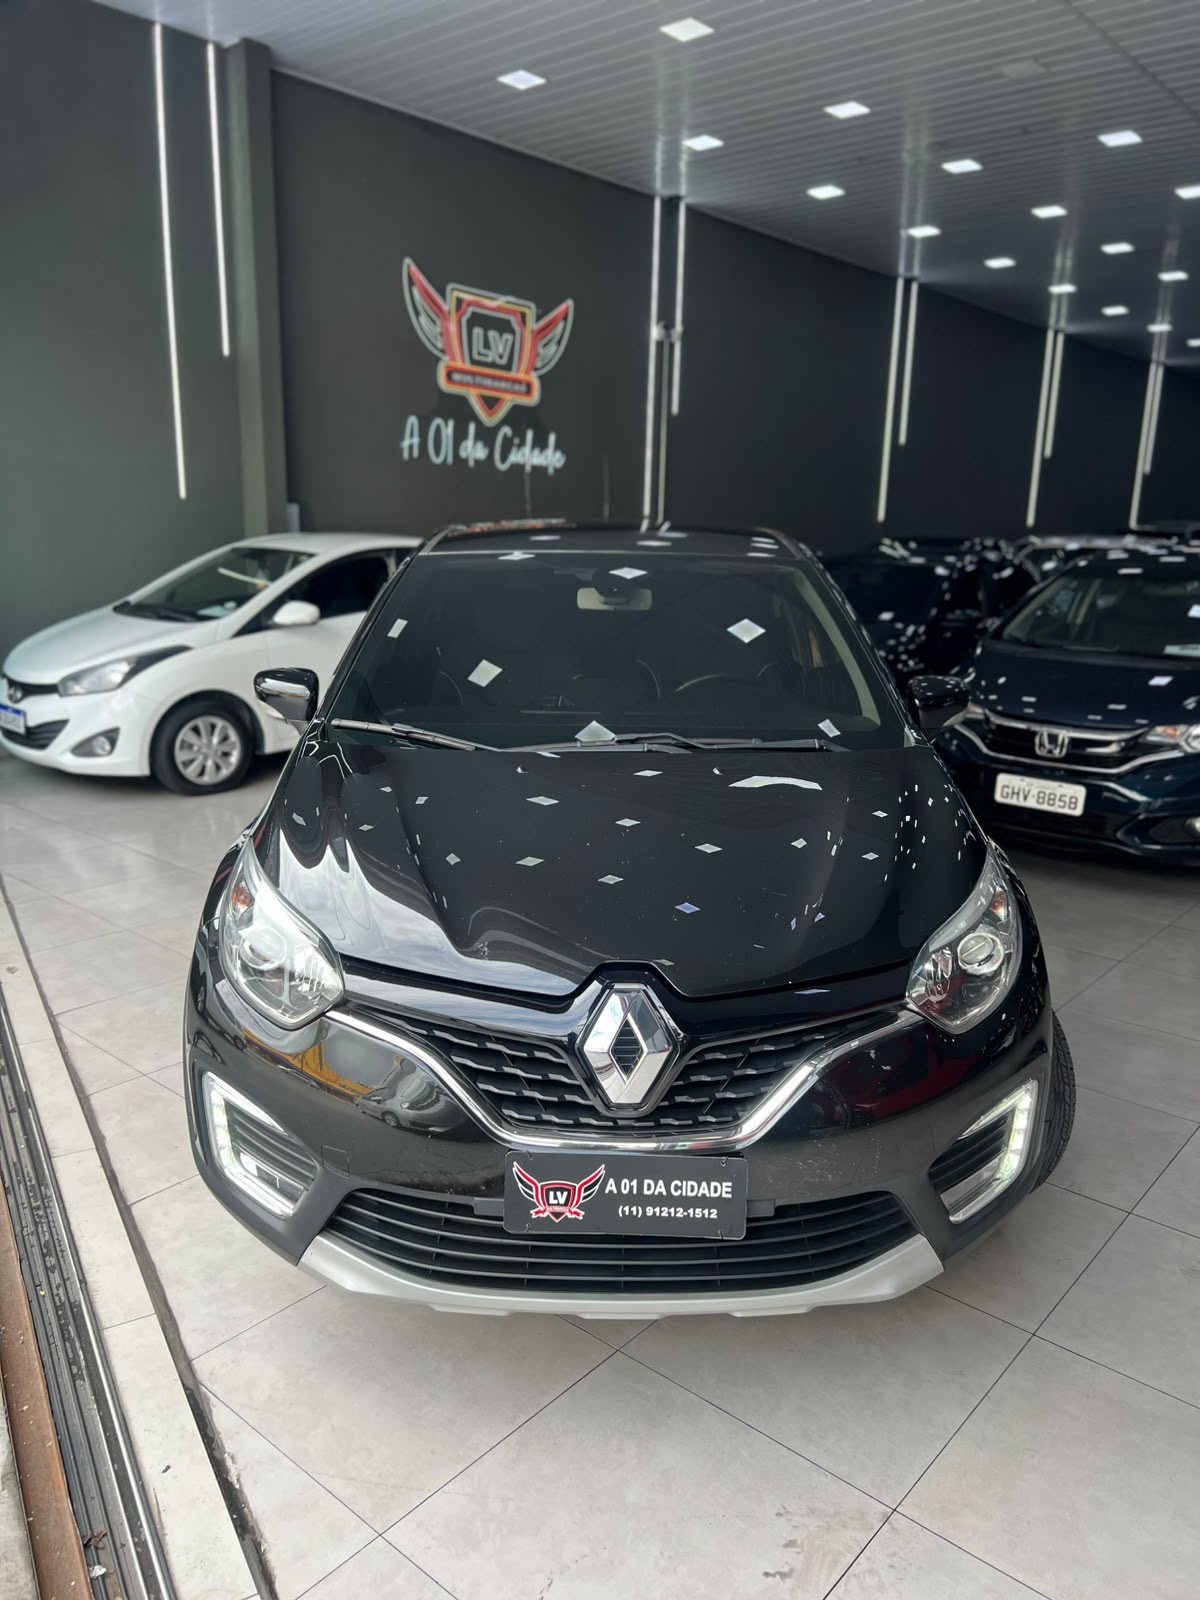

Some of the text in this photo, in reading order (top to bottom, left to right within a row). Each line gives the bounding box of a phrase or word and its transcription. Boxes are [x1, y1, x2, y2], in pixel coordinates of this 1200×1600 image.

[472, 326, 514, 365] LV
[401, 414, 567, 476] A 01 da Cidade
[548, 1191, 568, 1205] LV
[604, 1177, 733, 1199] A 01 DA CIDADE
[618, 1205, 718, 1219] (11) 91212-1512
